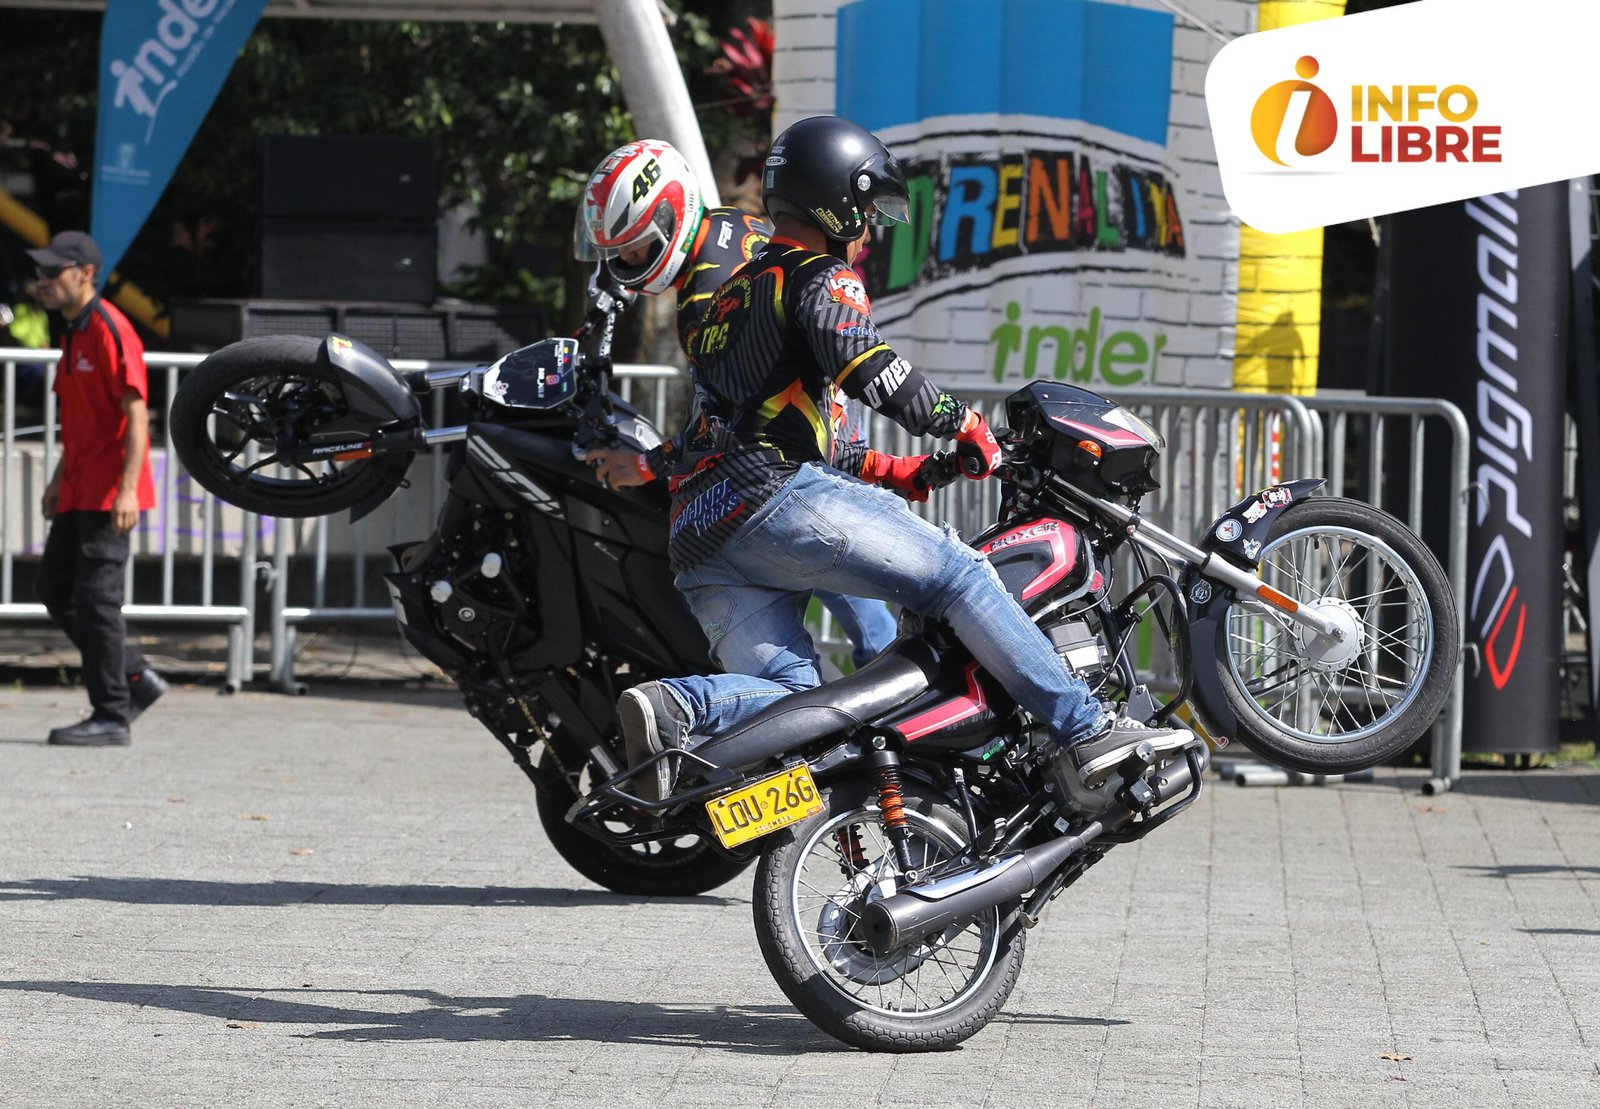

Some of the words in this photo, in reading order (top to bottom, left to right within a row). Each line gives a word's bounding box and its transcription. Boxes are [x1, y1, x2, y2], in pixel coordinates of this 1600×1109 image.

[632, 158, 662, 203] 46
[853, 157, 1185, 292] DRENALINA
[991, 301, 1167, 386] inder
[312, 442, 363, 454] RACELINE
[991, 522, 1060, 552] BOXER
[713, 795, 763, 835] LOU
[766, 776, 814, 816] 26G
[754, 814, 793, 833] COLOMBIA
